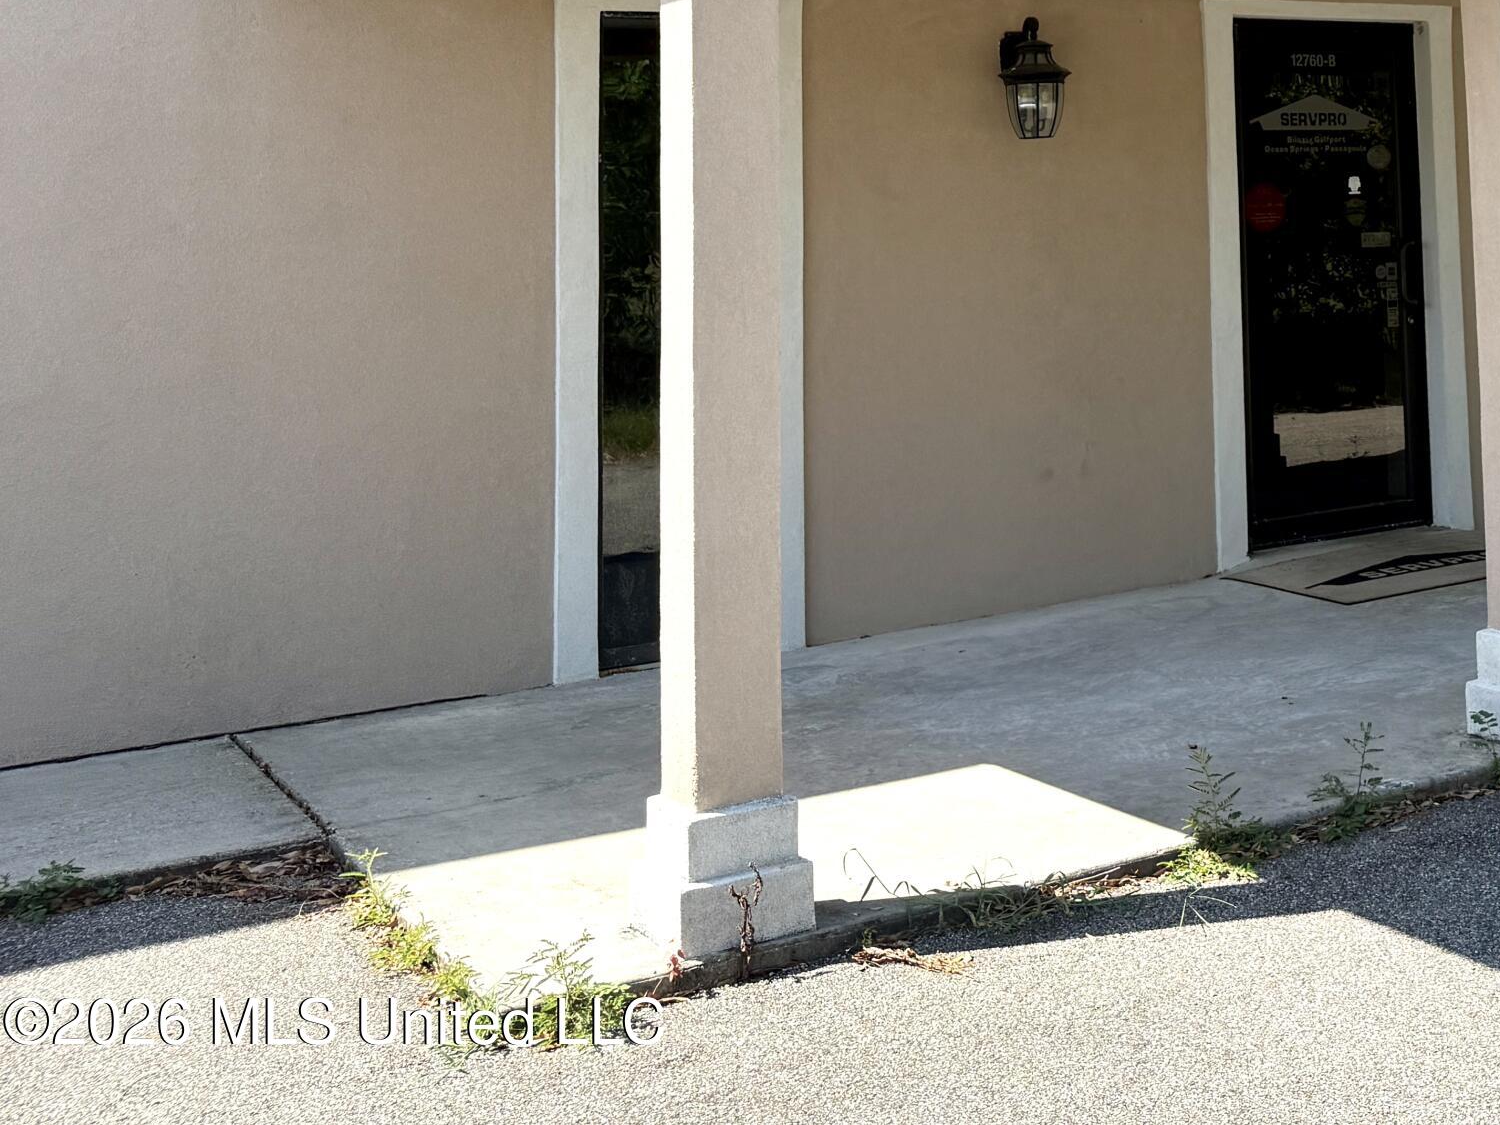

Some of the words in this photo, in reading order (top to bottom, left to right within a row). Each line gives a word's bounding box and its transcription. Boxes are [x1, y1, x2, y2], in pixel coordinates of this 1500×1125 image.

[1290, 53, 1337, 67] 12760-B
[1280, 112, 1347, 126] SERVPRO
[1359, 552, 1486, 579] SERVPR
